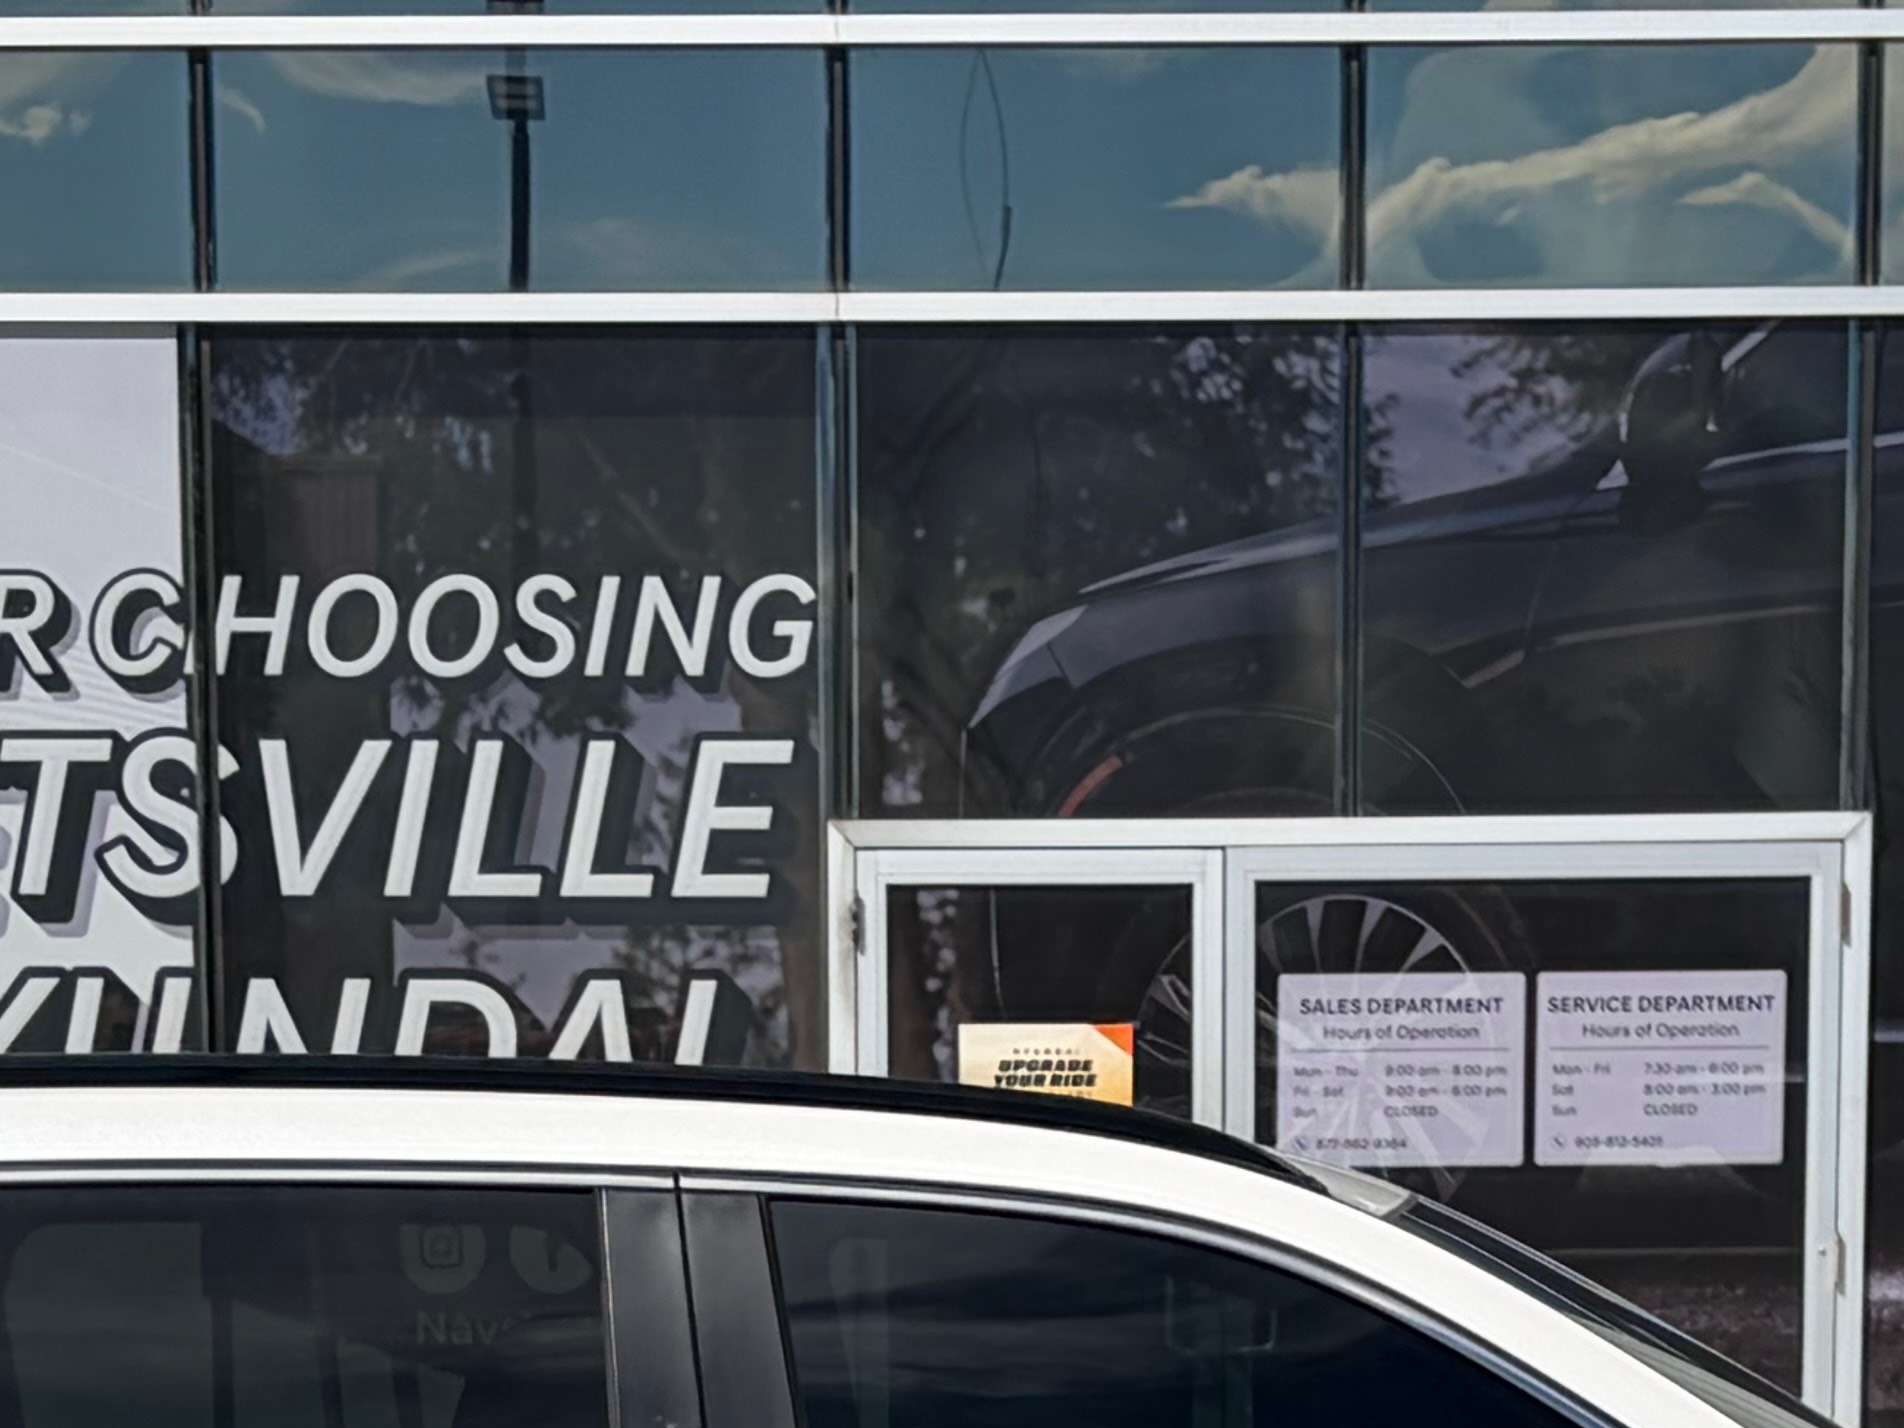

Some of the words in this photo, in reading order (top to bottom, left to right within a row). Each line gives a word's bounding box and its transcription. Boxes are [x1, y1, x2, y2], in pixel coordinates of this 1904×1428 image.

[89, 569, 819, 694] CHOOSING
[1299, 998, 1362, 1016] SALES
[1367, 996, 1504, 1015] DEPARTMENT
[1547, 996, 1633, 1013] SERVICE
[1638, 994, 1776, 1013] DEPARTMENT
[1322, 1025, 1371, 1039] Hours
[1375, 1024, 1392, 1039] of
[1396, 1024, 1480, 1041] Operation
[1582, 1022, 1630, 1037] Hours
[1635, 1022, 1652, 1037] of
[1655, 1022, 1740, 1040] Operation
[998, 1059, 1094, 1072] UPGRADE
[1050, 1073, 1097, 1087] RIDE
[1383, 1105, 1439, 1118] CLOSED
[1643, 1103, 1699, 1117] CLOSED
